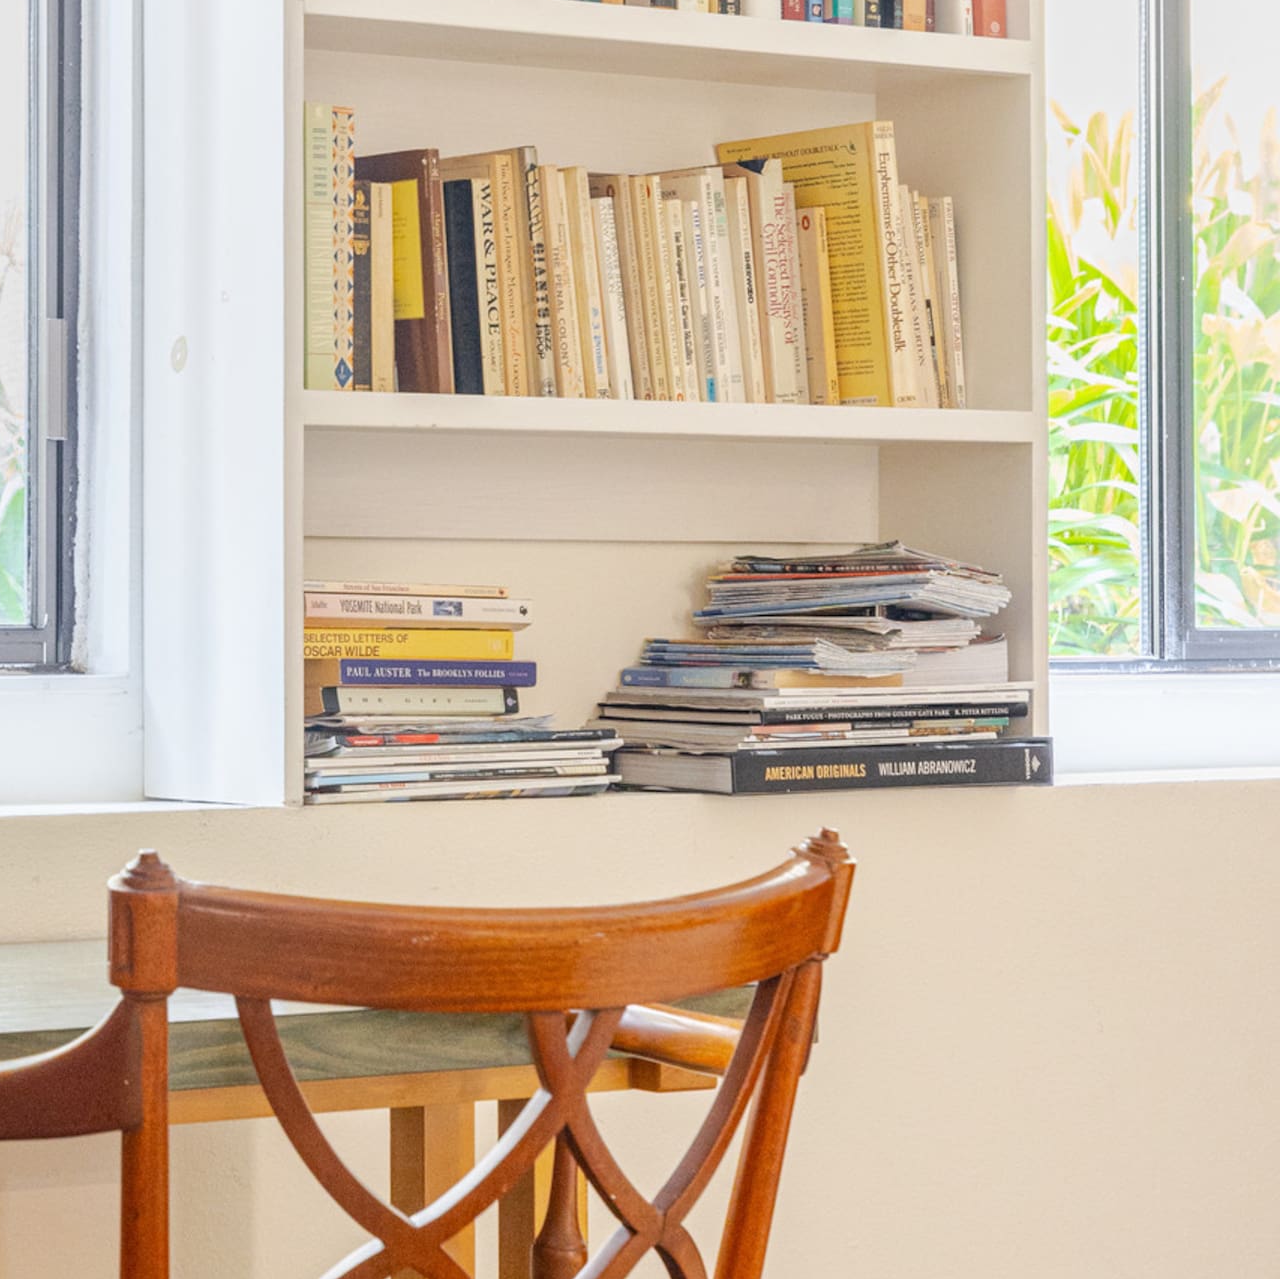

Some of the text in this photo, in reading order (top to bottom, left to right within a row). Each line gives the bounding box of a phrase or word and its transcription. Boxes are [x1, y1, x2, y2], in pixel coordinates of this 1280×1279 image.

[773, 194, 785, 219] The
[877, 151, 894, 230] Euphemisms
[479, 183, 501, 336] WAR & PEACE
[775, 223, 792, 281] Selected
[885, 242, 899, 281] Other
[763, 222, 784, 320] Cyril Connolly
[553, 246, 571, 368] THE PENAL COLONY
[780, 284, 796, 329] Essays
[888, 282, 907, 353] Doubletalk
[339, 600, 423, 615] YOSEMITE National Park
[303, 632, 409, 644] SELECTED LETTERS OF
[303, 645, 380, 657] OSCAR WILDE
[346, 667, 412, 678] PAUL AUSTER
[416, 668, 506, 678] The BROOKLYN FOLLIES
[764, 763, 866, 781] AMERICAN ORIGINALS
[877, 759, 977, 777] WILLIAM ABRANOWICZ
